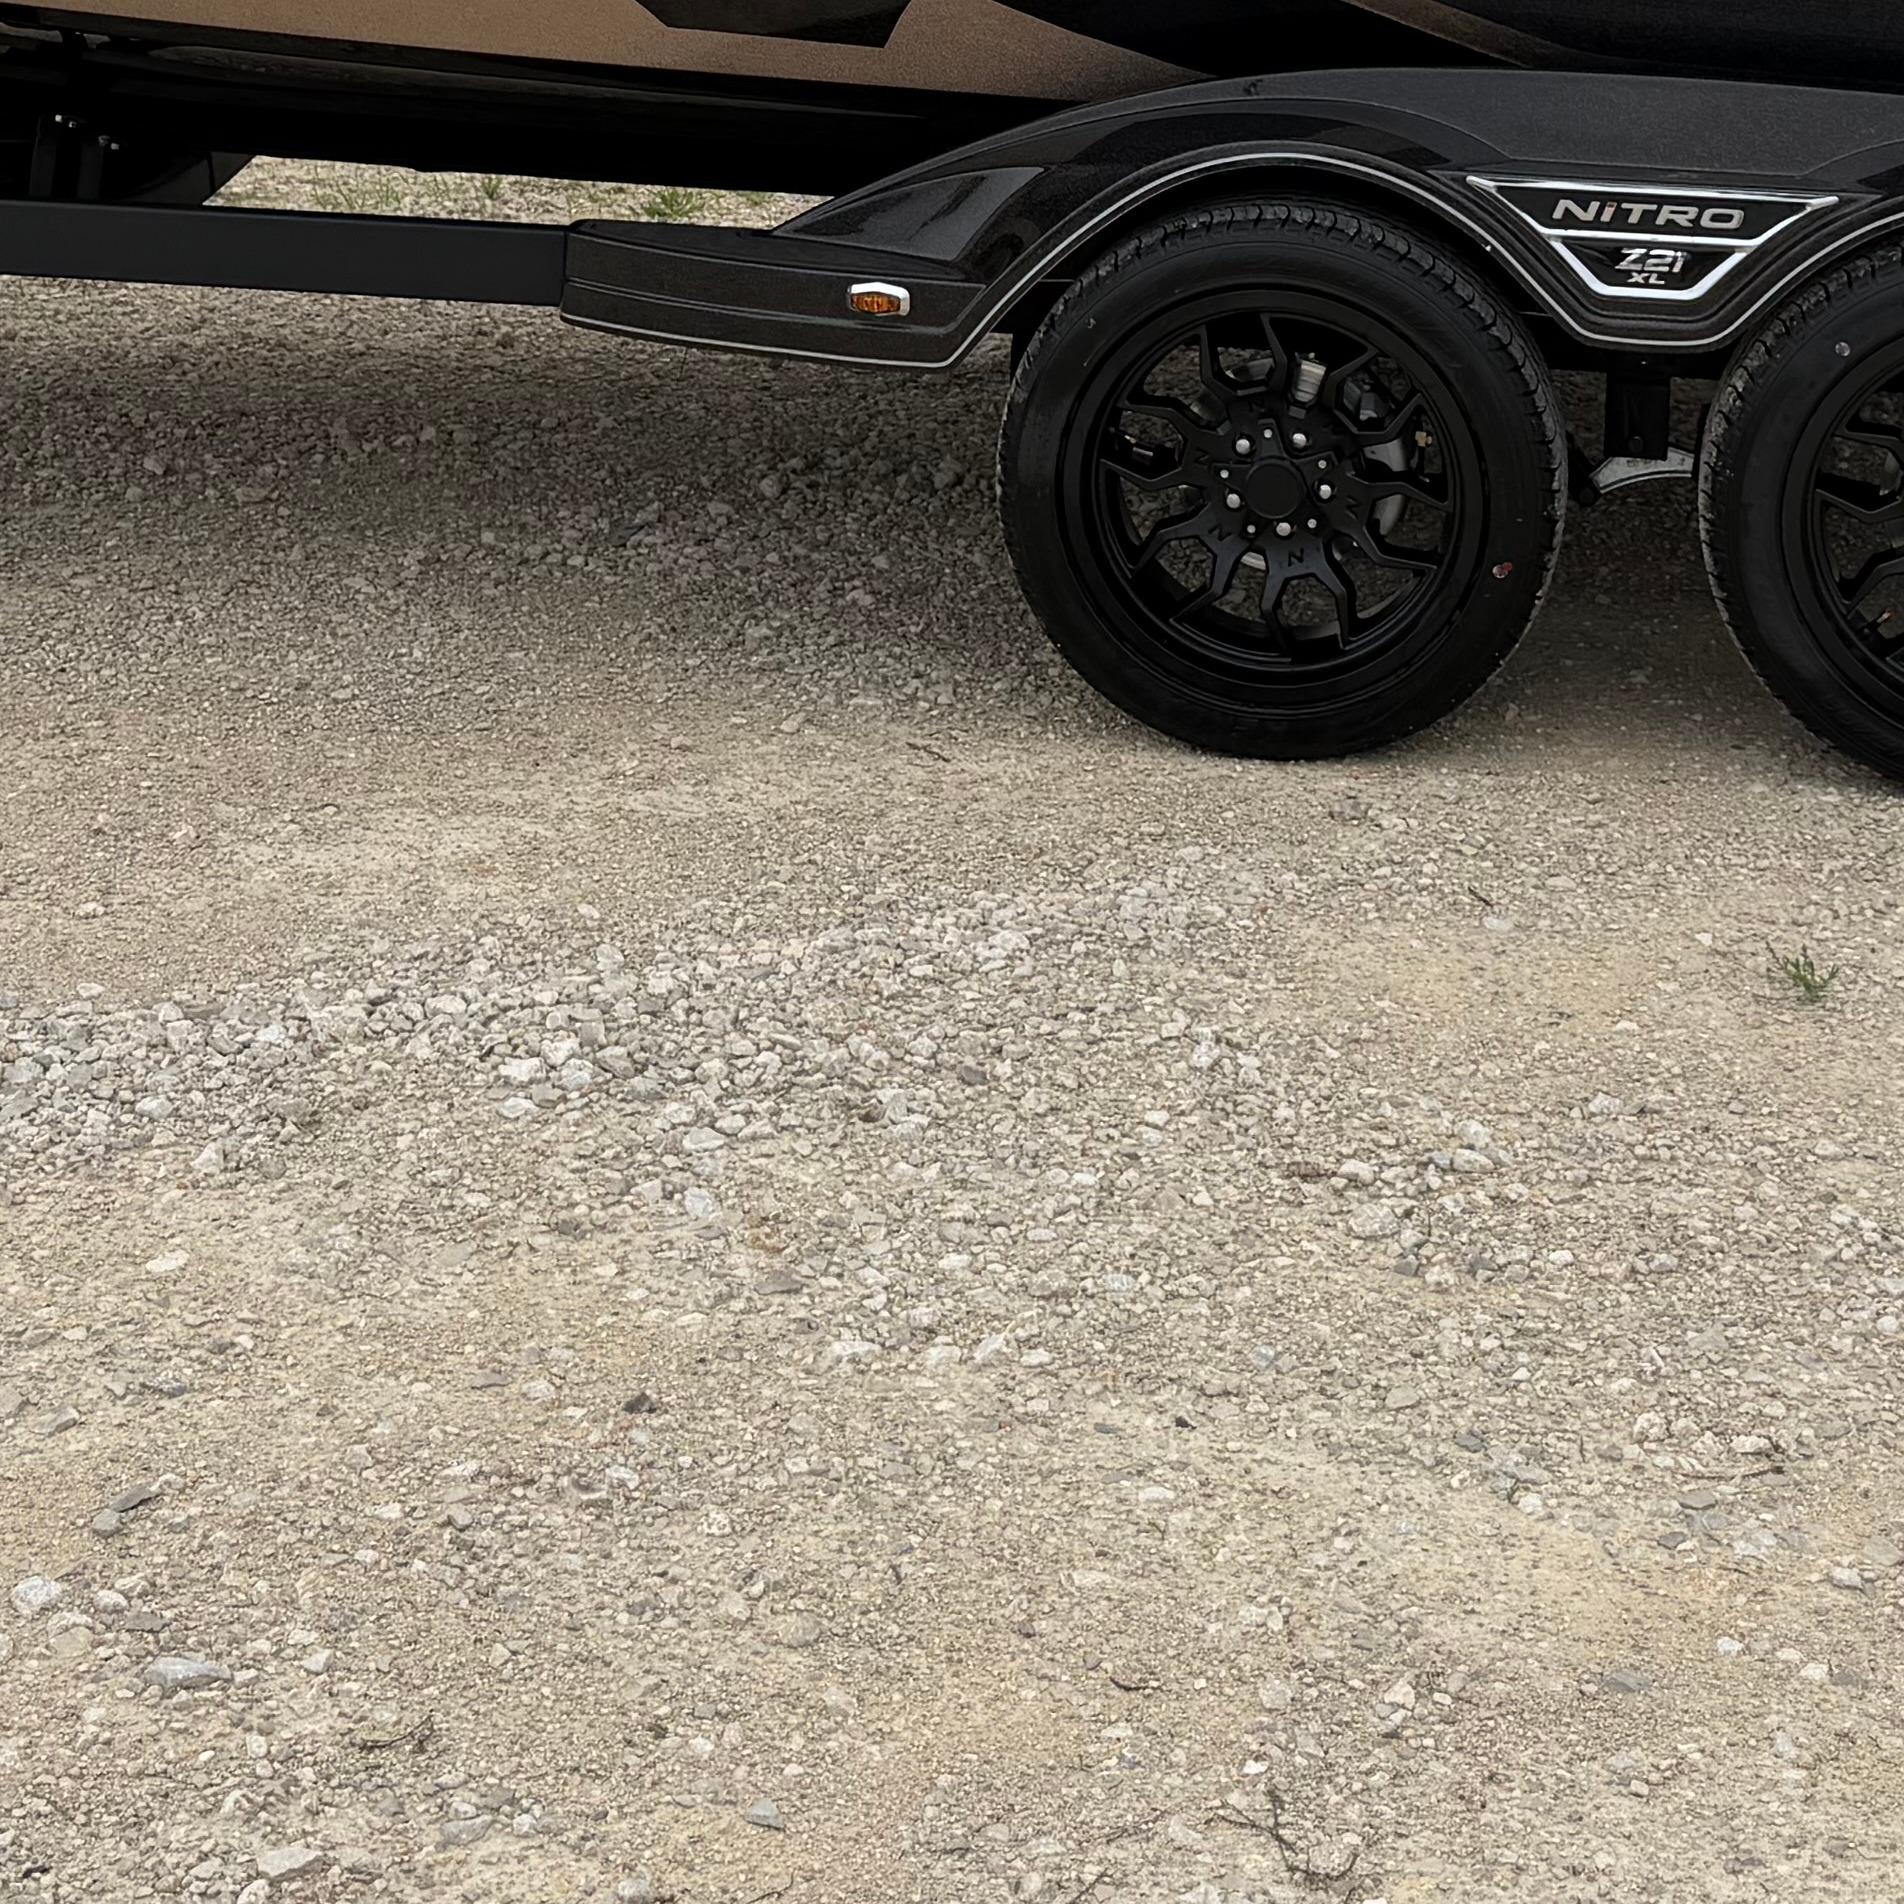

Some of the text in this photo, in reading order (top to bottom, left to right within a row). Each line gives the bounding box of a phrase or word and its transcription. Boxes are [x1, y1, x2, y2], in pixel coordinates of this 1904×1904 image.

[1552, 199, 1746, 230] NITRO
[1614, 247, 1686, 274] Z21
[1626, 272, 1667, 285] XL
